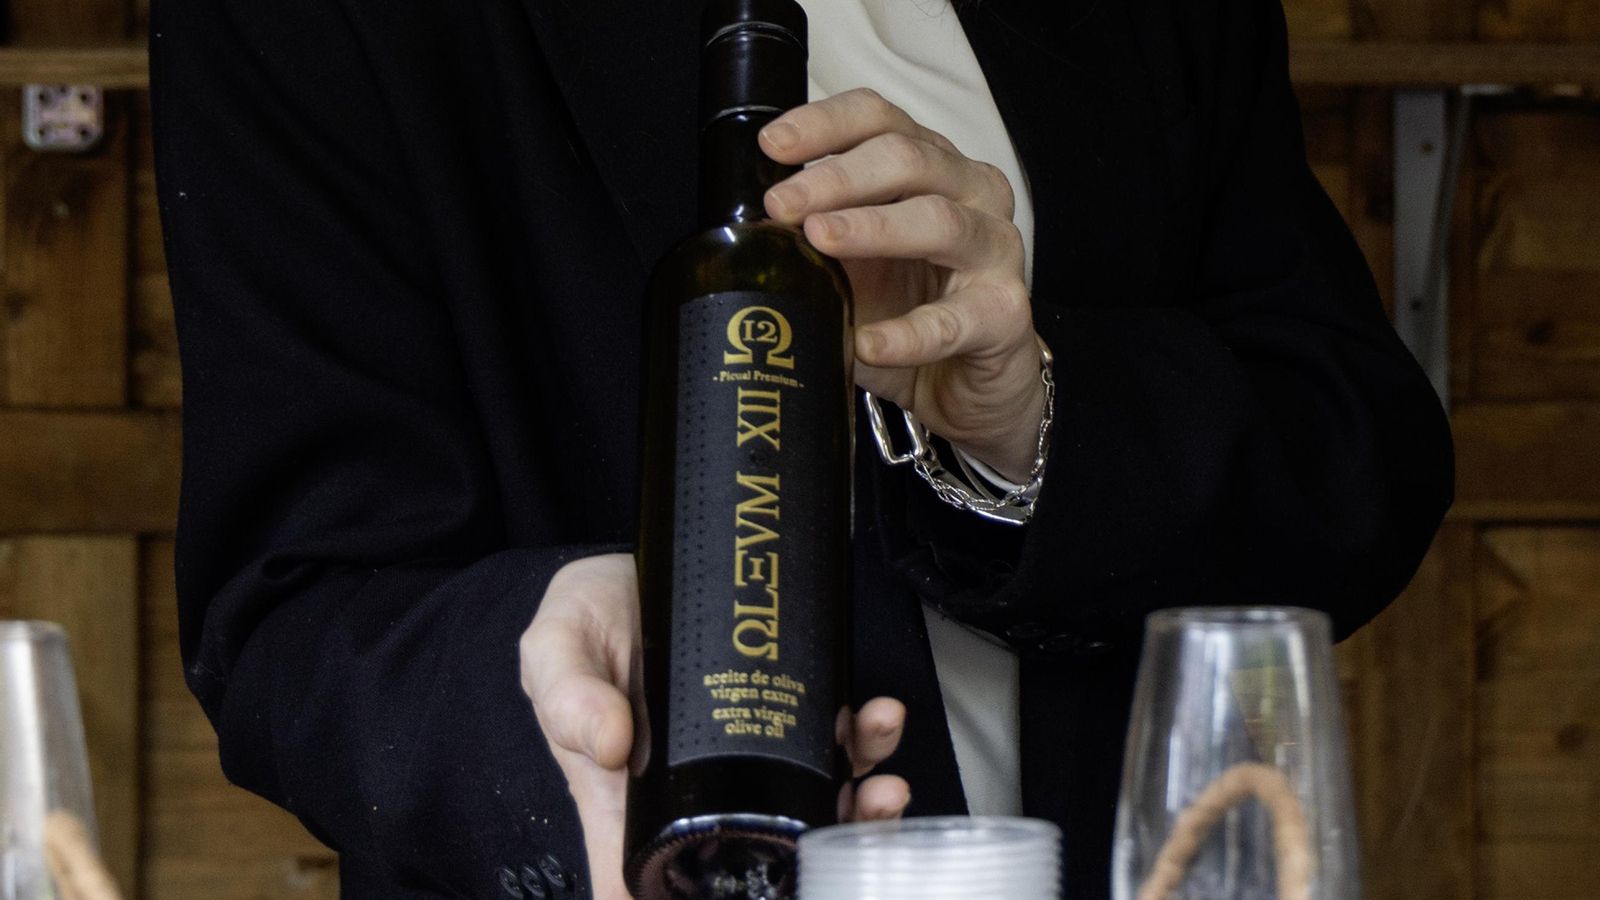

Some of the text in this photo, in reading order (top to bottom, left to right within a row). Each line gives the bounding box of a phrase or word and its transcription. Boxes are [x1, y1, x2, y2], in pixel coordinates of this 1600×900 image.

[742, 320, 778, 342] 12
[753, 370, 798, 387] Premium
[737, 386, 781, 451] XII
[703, 669, 806, 694] aceite de oliva
[710, 685, 799, 706] virgen extra
[712, 705, 798, 727] extra virgin
[725, 719, 785, 738] olive oil
